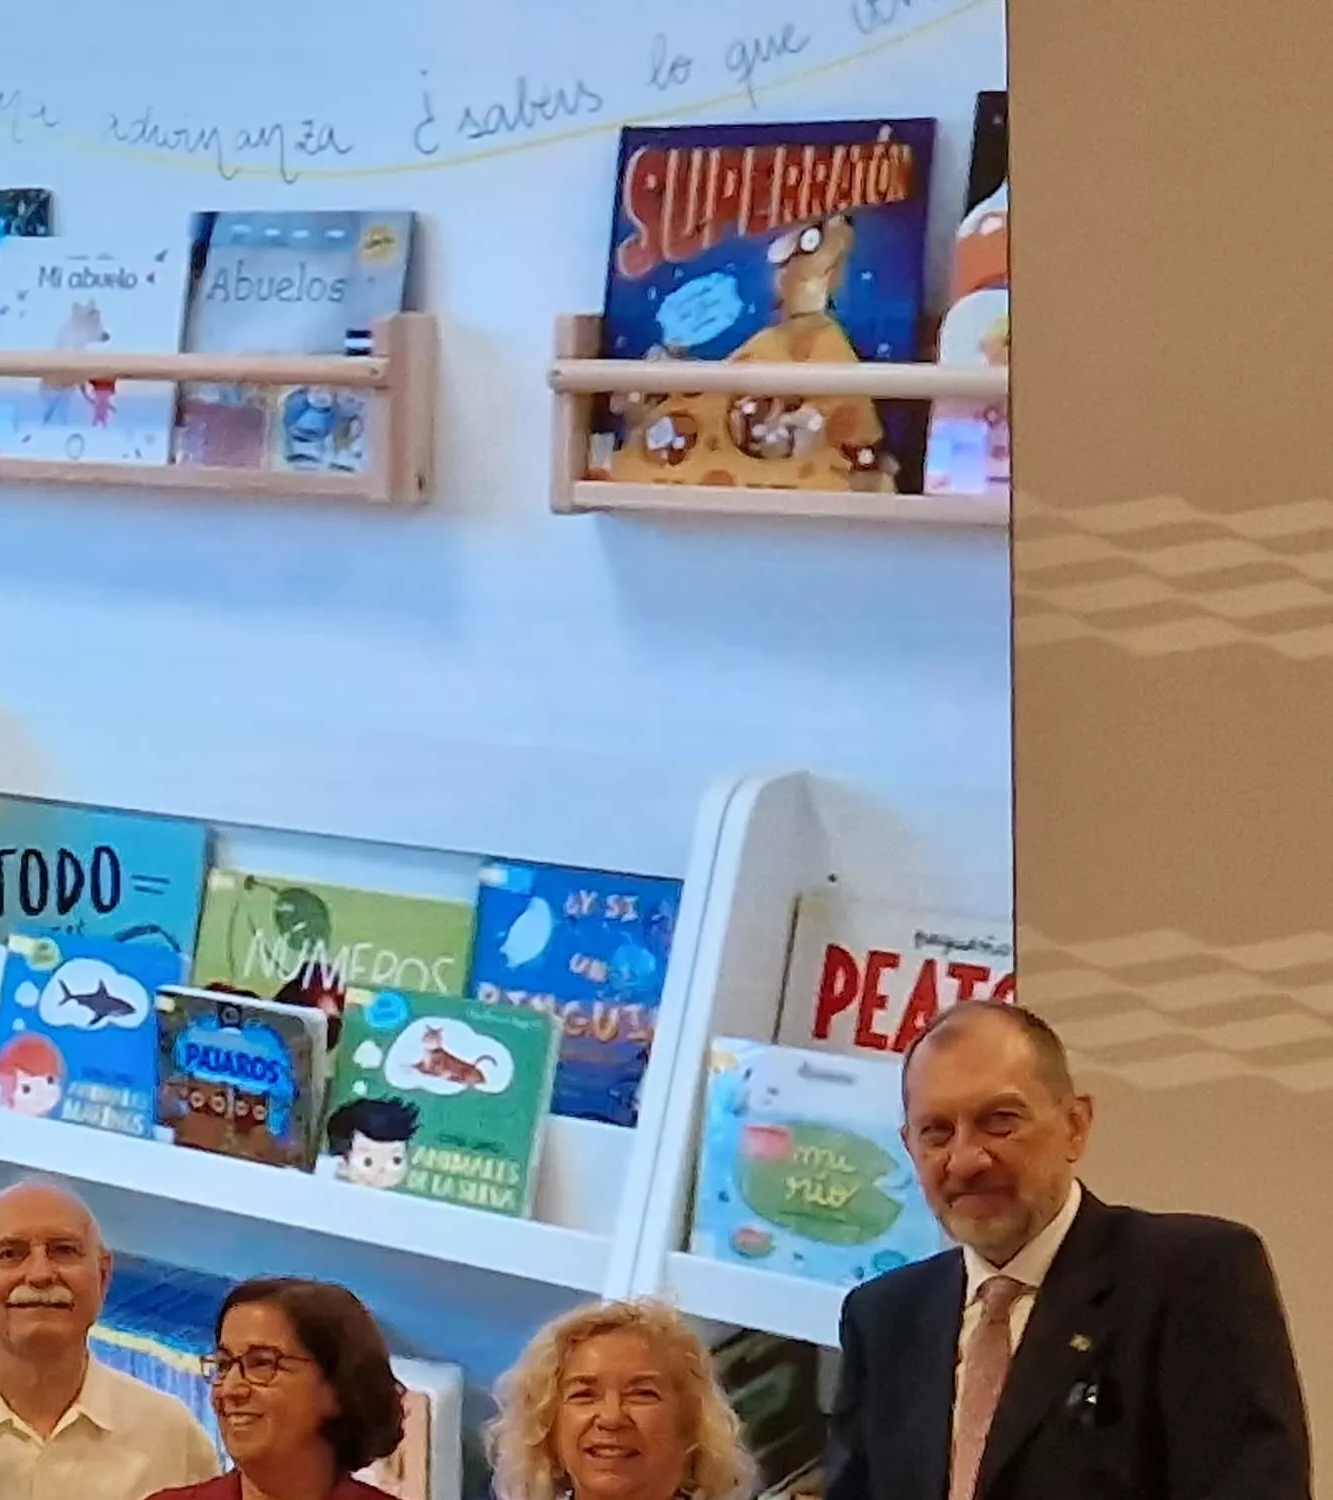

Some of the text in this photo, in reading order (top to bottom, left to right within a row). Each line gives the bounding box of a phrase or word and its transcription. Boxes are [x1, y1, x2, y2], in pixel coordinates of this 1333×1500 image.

[648, 33, 692, 91] lo
[725, 22, 810, 109] que
[38, 266, 139, 290] Mi abuelo
[206, 259, 348, 304] Abuelos
[411, 1146, 522, 1186] ANIMALES
